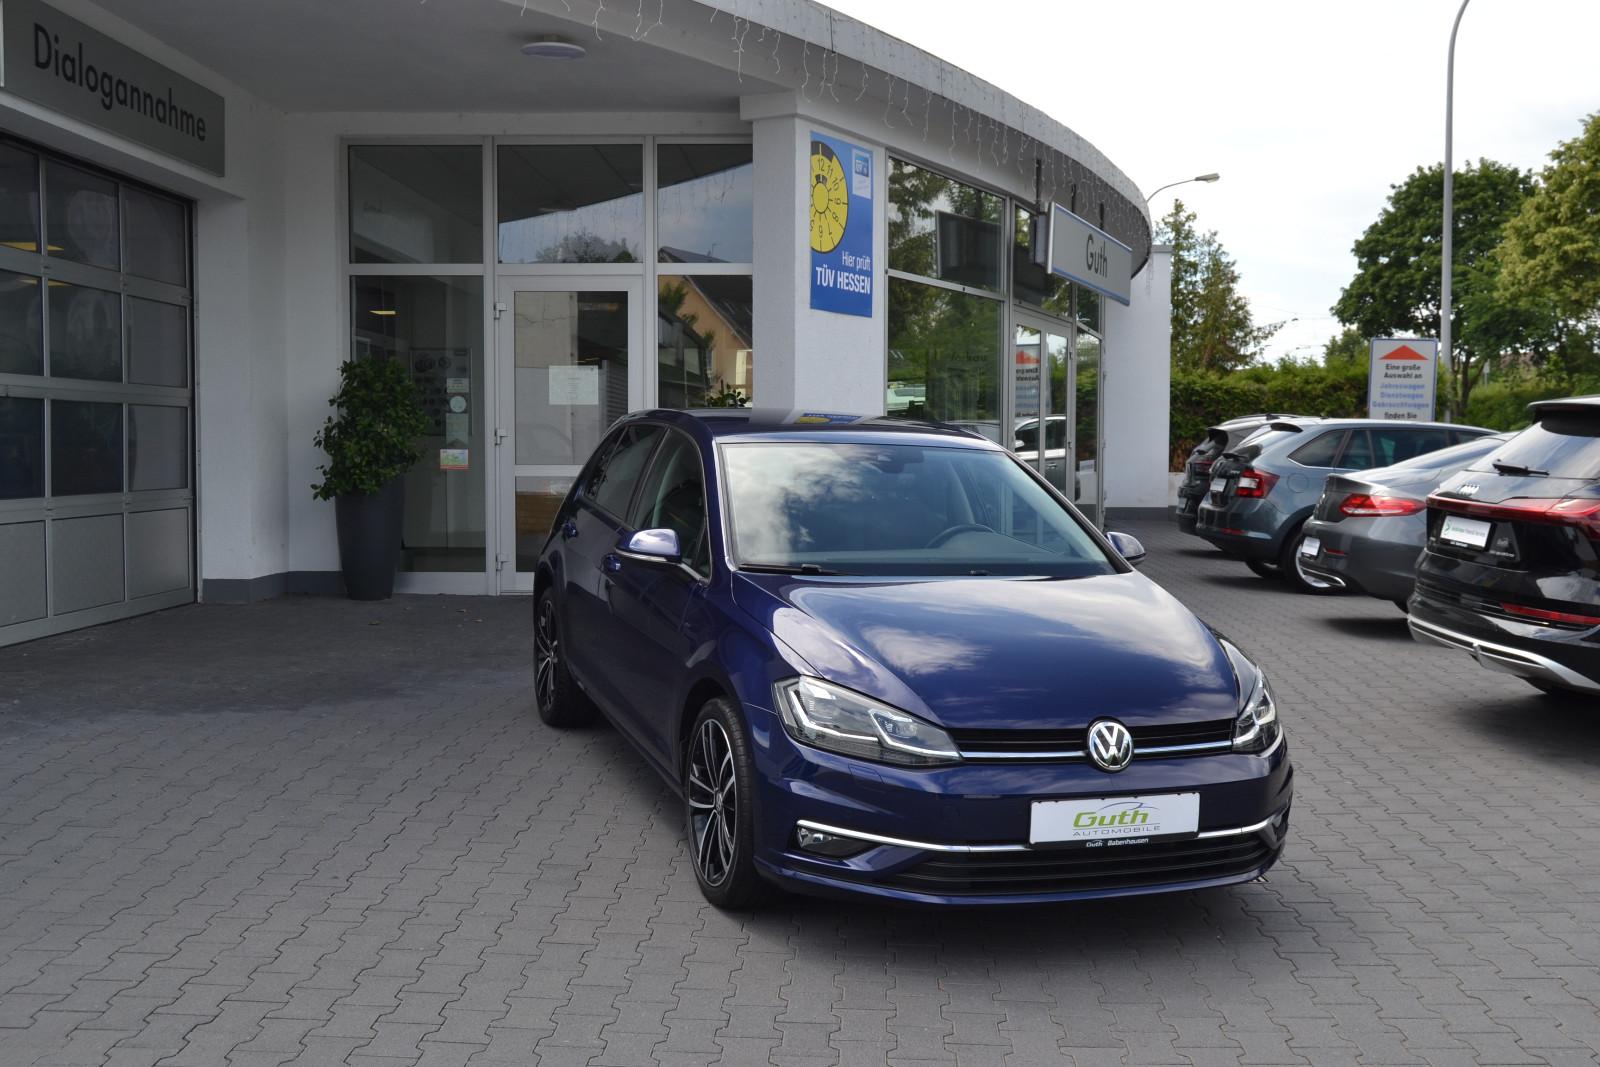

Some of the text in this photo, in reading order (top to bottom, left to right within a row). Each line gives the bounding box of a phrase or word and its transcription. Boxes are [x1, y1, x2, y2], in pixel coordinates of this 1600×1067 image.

[33, 22, 207, 141] Dialogannahme
[817, 158, 825, 172] 12
[842, 250, 871, 272] Hier prüft
[1086, 233, 1108, 279] Guth
[815, 263, 871, 295] TÜV HESSEN
[1401, 363, 1421, 372] große
[1384, 411, 1417, 419] finden Sie
[1089, 720, 1132, 769] VW
[1073, 810, 1149, 828] Guth
[1073, 825, 1161, 837] AUTOMOBILE
[1107, 838, 1149, 846] Babenhausen
